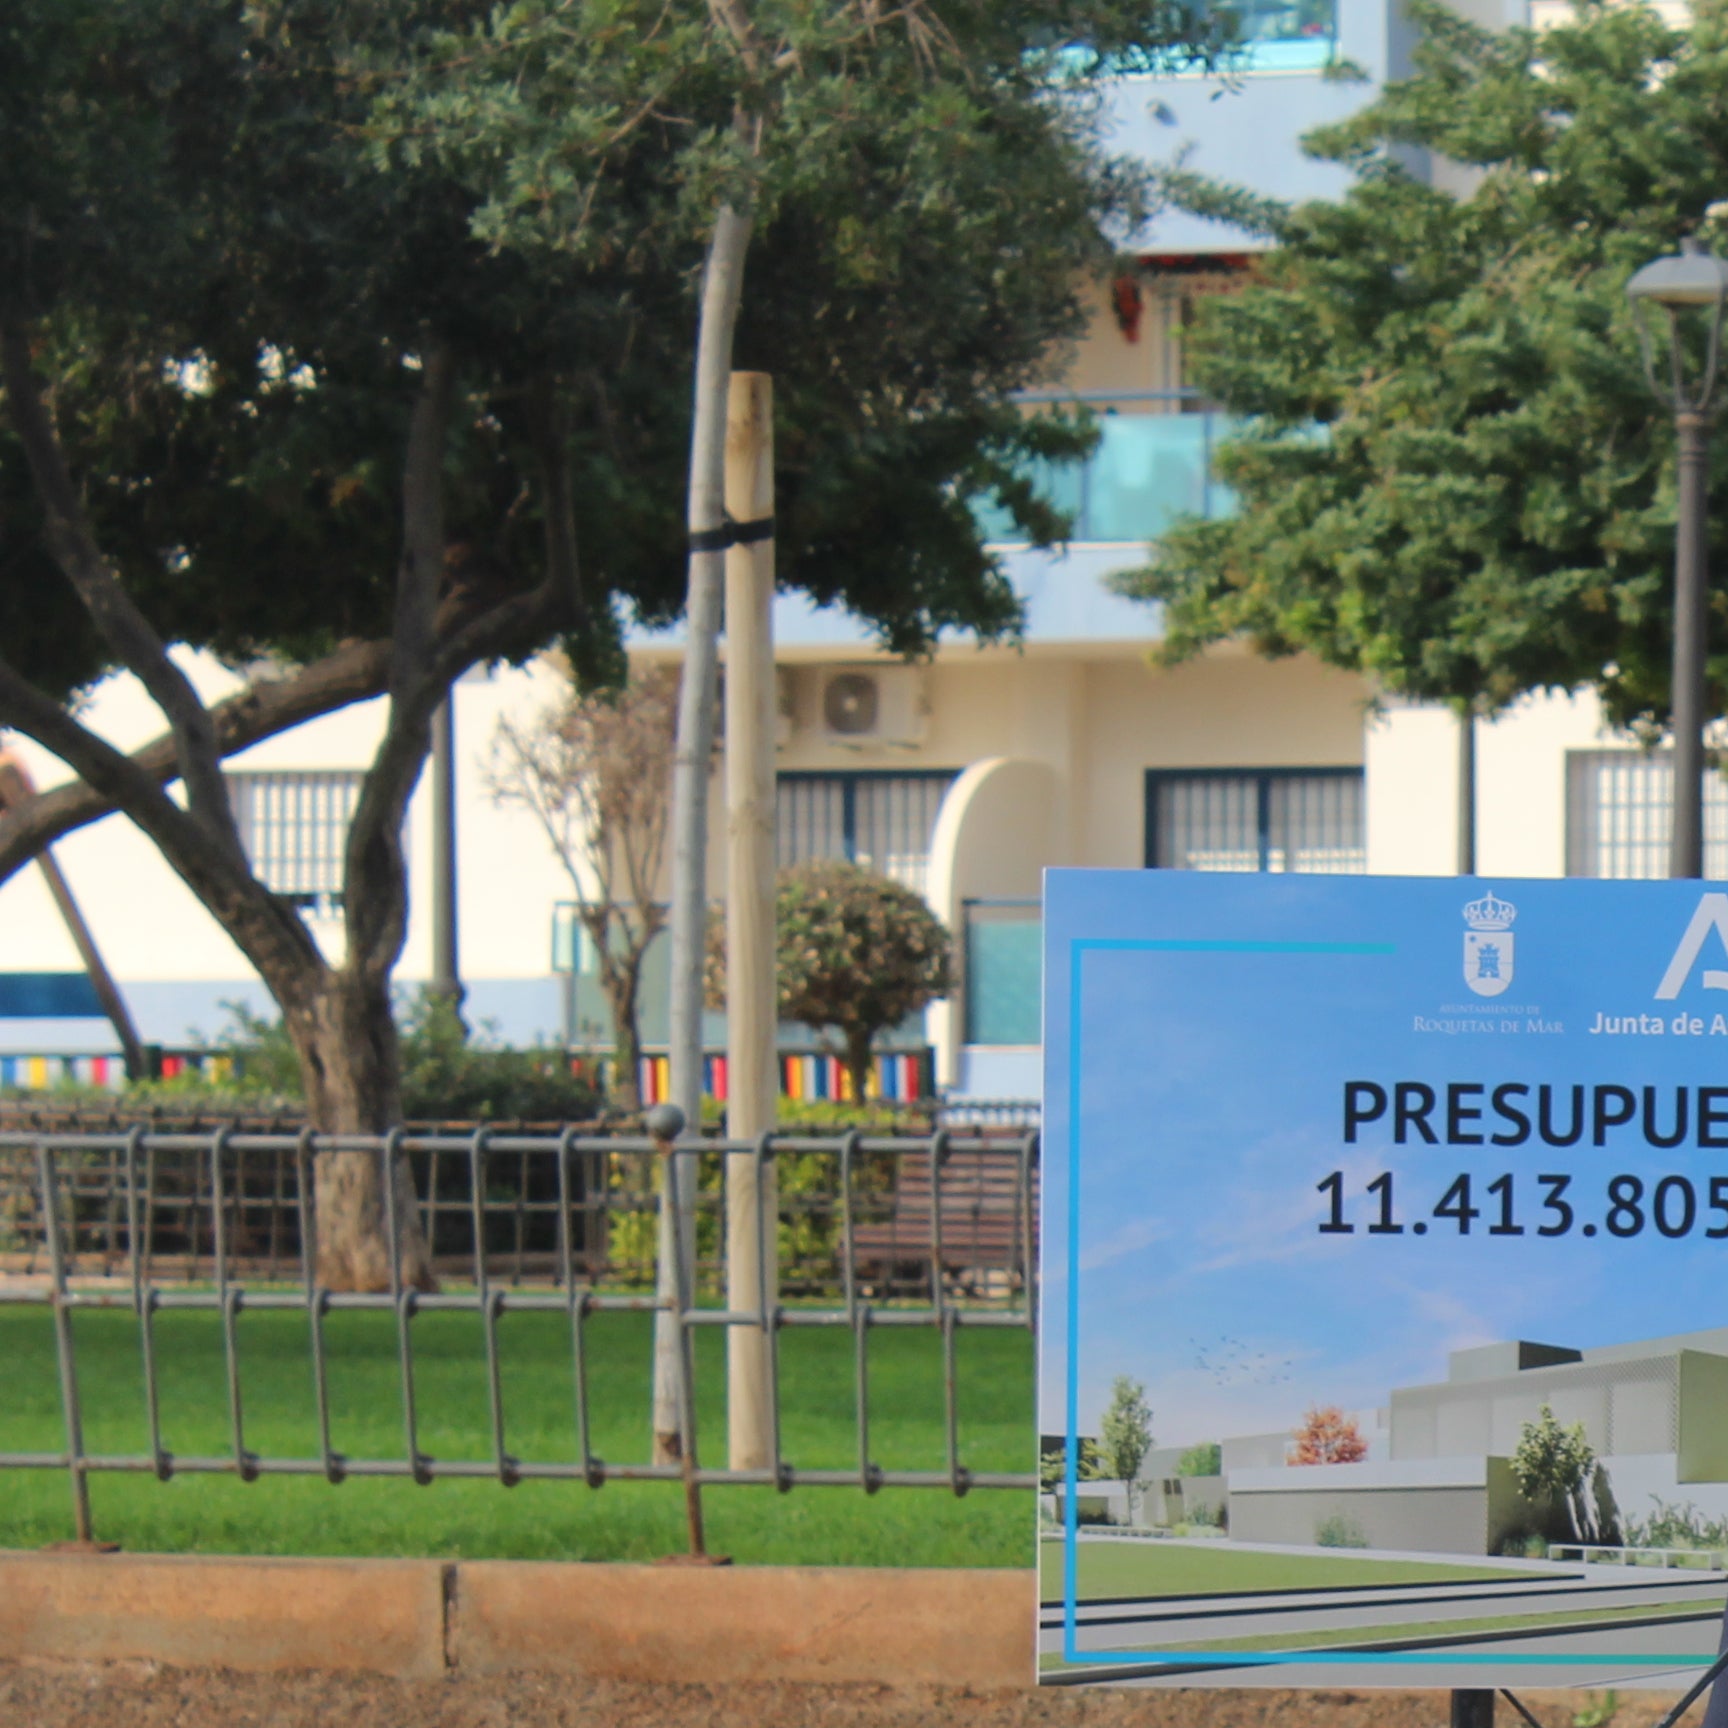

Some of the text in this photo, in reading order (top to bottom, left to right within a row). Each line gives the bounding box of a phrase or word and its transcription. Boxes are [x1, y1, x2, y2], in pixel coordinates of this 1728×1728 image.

[1413, 1016, 1565, 1035] ROQUETAS DE MAR
[1589, 1012, 1665, 1036] Junta
[1671, 1012, 1703, 1036] de
